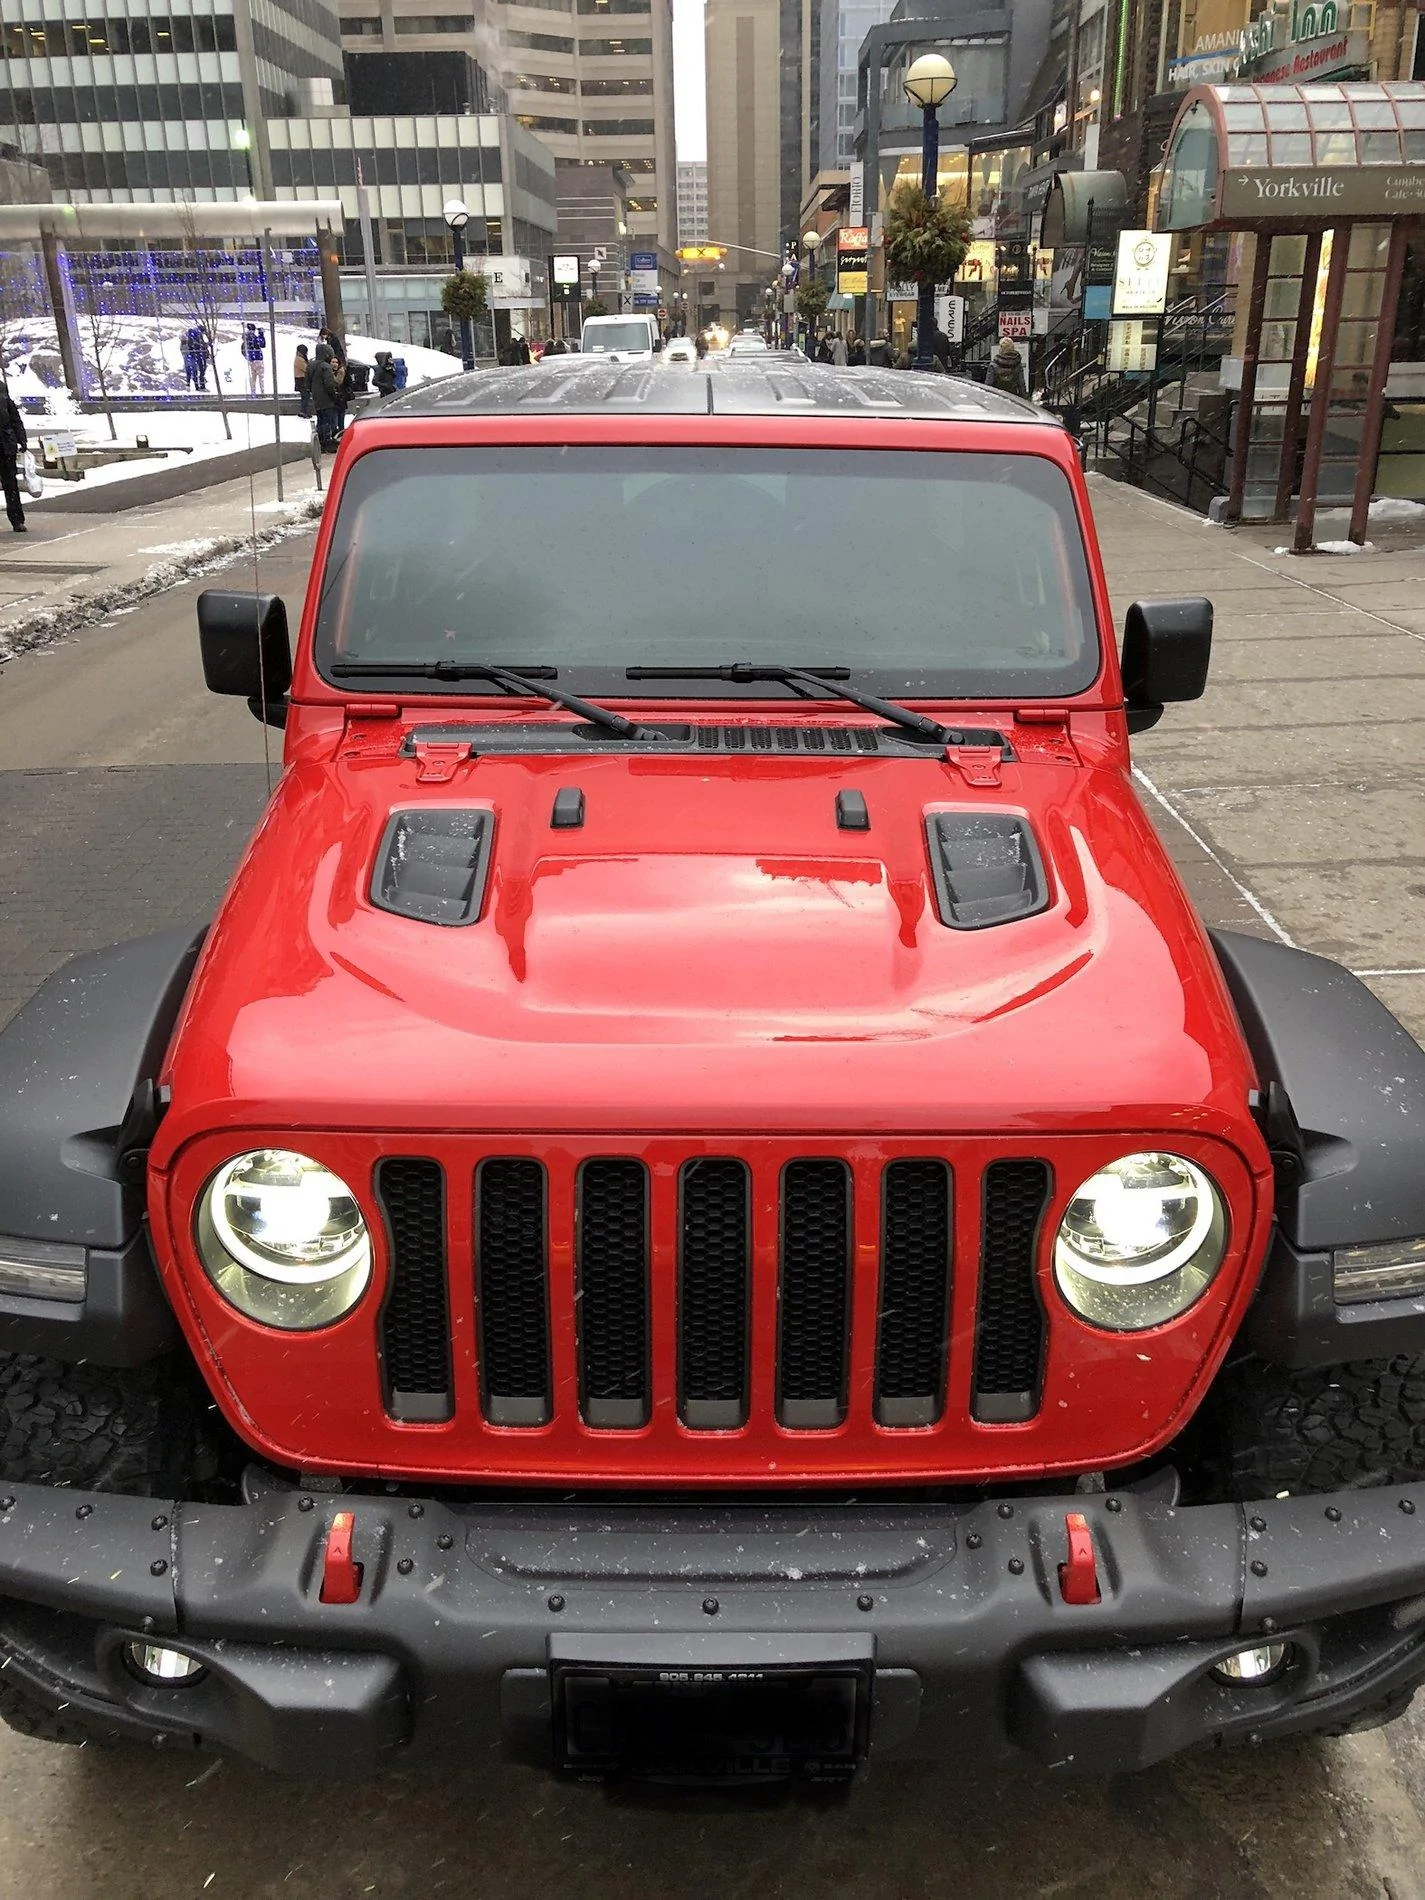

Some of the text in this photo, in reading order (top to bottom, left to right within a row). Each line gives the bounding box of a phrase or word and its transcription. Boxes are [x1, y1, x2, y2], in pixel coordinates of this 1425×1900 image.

[1290, 0, 1339, 44] Inn
[1293, 35, 1349, 75] Restaurant
[1202, 60, 1230, 76] SKIN
[850, 176, 862, 214] FIORIO
[1254, 176, 1345, 199] Yorkville
[1000, 316, 1031, 326] NAILS
[1002, 327, 1027, 337] SPA
